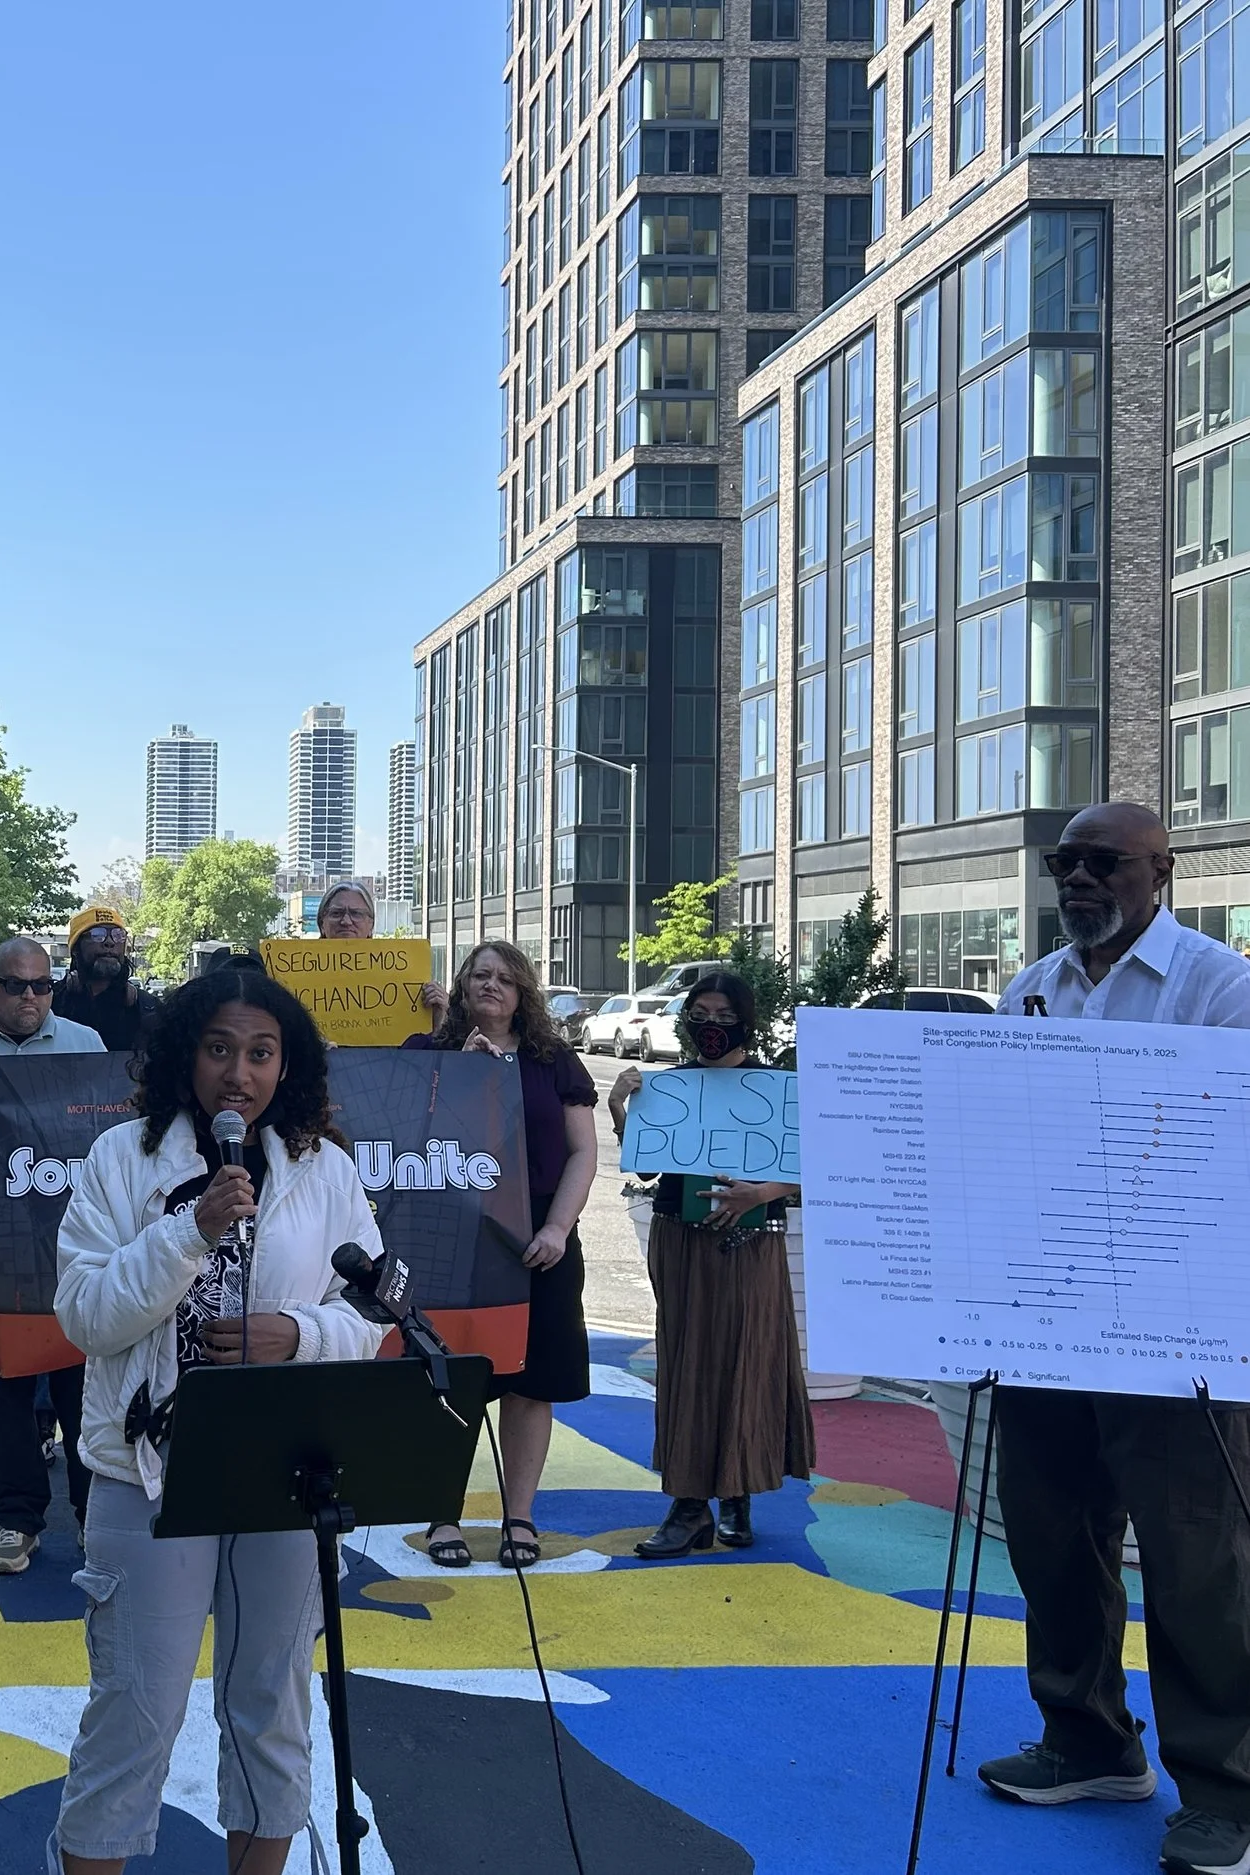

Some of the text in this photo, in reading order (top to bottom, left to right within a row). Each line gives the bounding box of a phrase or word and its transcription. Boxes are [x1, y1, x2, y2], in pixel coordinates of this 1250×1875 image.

[330, 1018, 362, 1030] BRONX
[364, 1016, 392, 1028] UNITE
[922, 1028, 1084, 1044] Site-specific PM2.5 Step Estimates,
[923, 1038, 944, 1046] Post
[946, 1038, 998, 1050] Congestion
[1000, 1040, 1028, 1052] Policy
[1030, 1042, 1100, 1054] Implementation
[1103, 1045, 1140, 1057] January
[1154, 1048, 1178, 1058] 2025
[638, 1071, 799, 1130] SI SE
[66, 1104, 130, 1114] MOTT HAVEN
[634, 1128, 800, 1175] PUEDE
[354, 1138, 501, 1192] Unite
[384, 1270, 400, 1302] SPECTRUM
[393, 1274, 407, 1302] NEWS
[1186, 1326, 1200, 1334] 0.5
[1100, 1330, 1142, 1341] Estimated
[1143, 1333, 1163, 1343] Step
[1164, 1335, 1196, 1345] Change
[999, 1340, 1015, 1348] -0.5
[1026, 1342, 1048, 1350] -0.25
[1070, 1344, 1092, 1354] -0.25
[1093, 1346, 1102, 1354] to
[1140, 1349, 1148, 1357] to
[1150, 1350, 1168, 1358] 0.25
[1190, 1352, 1208, 1360] 0.25
[1220, 1354, 1234, 1362] 0.5
[954, 1367, 964, 1375] CI
[1028, 1371, 1070, 1382] Significant
